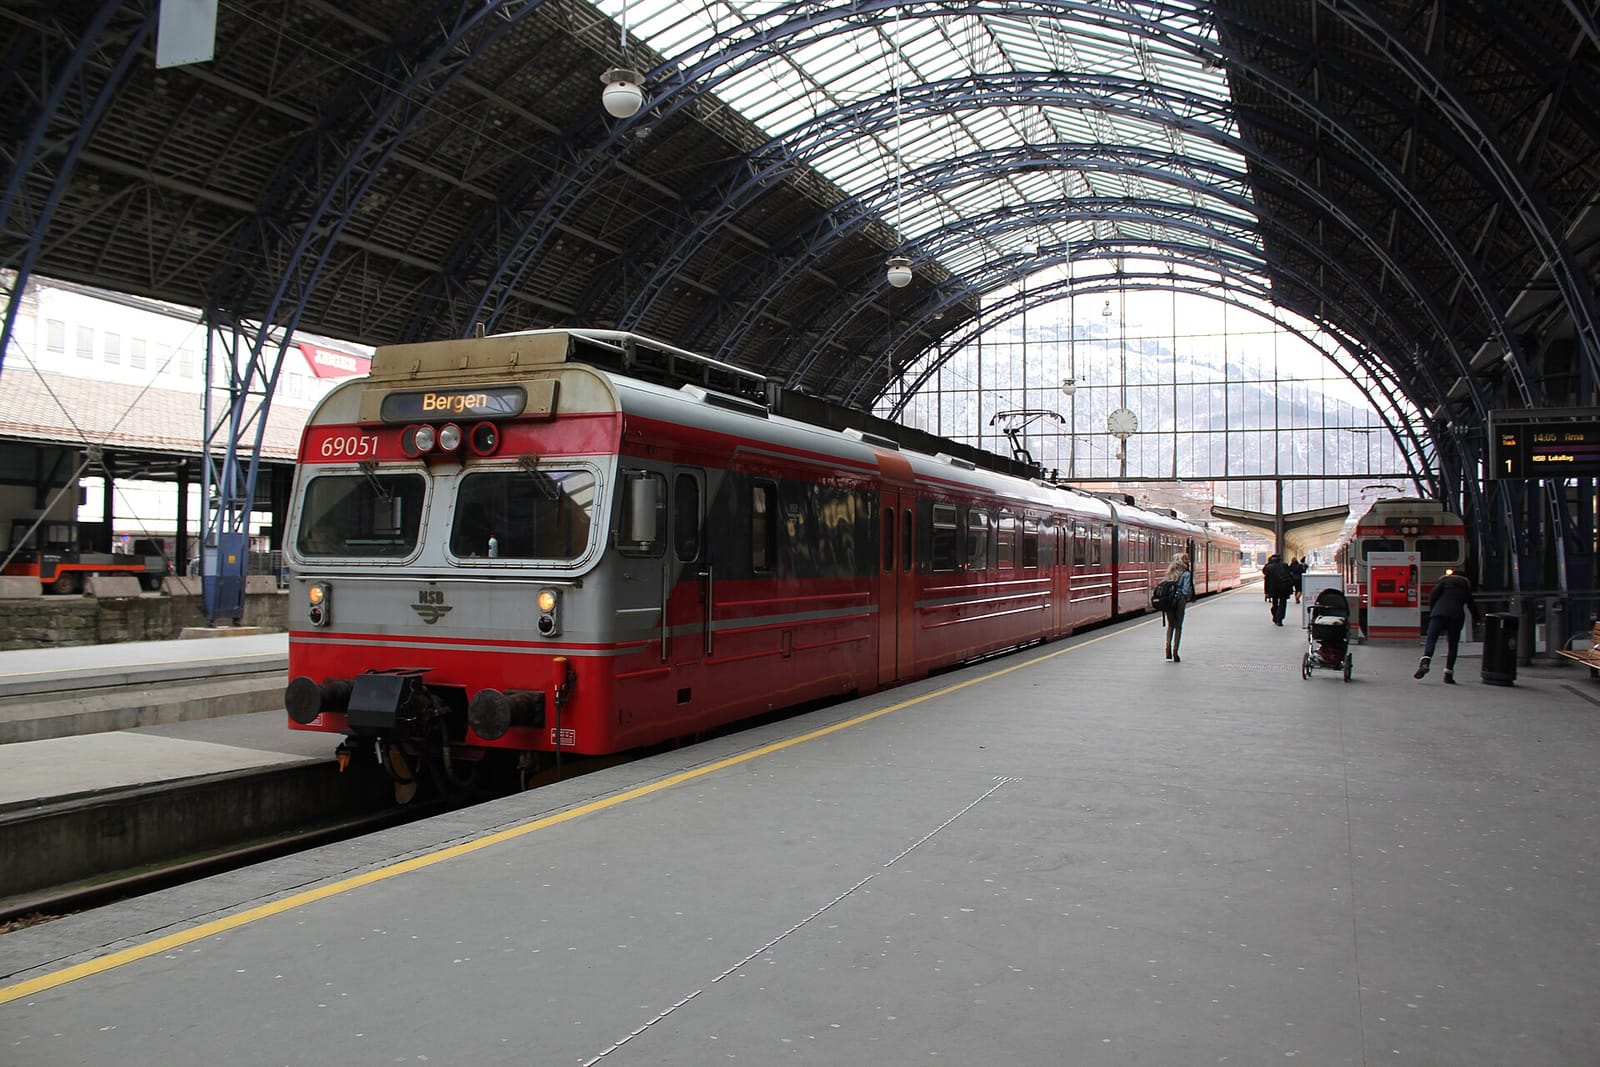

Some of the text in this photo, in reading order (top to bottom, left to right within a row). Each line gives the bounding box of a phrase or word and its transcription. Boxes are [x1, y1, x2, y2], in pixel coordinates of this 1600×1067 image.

[422, 392, 488, 413] Bergen
[321, 435, 378, 457] 69051
[1505, 459, 1513, 473] 1
[418, 590, 444, 604] NSB
